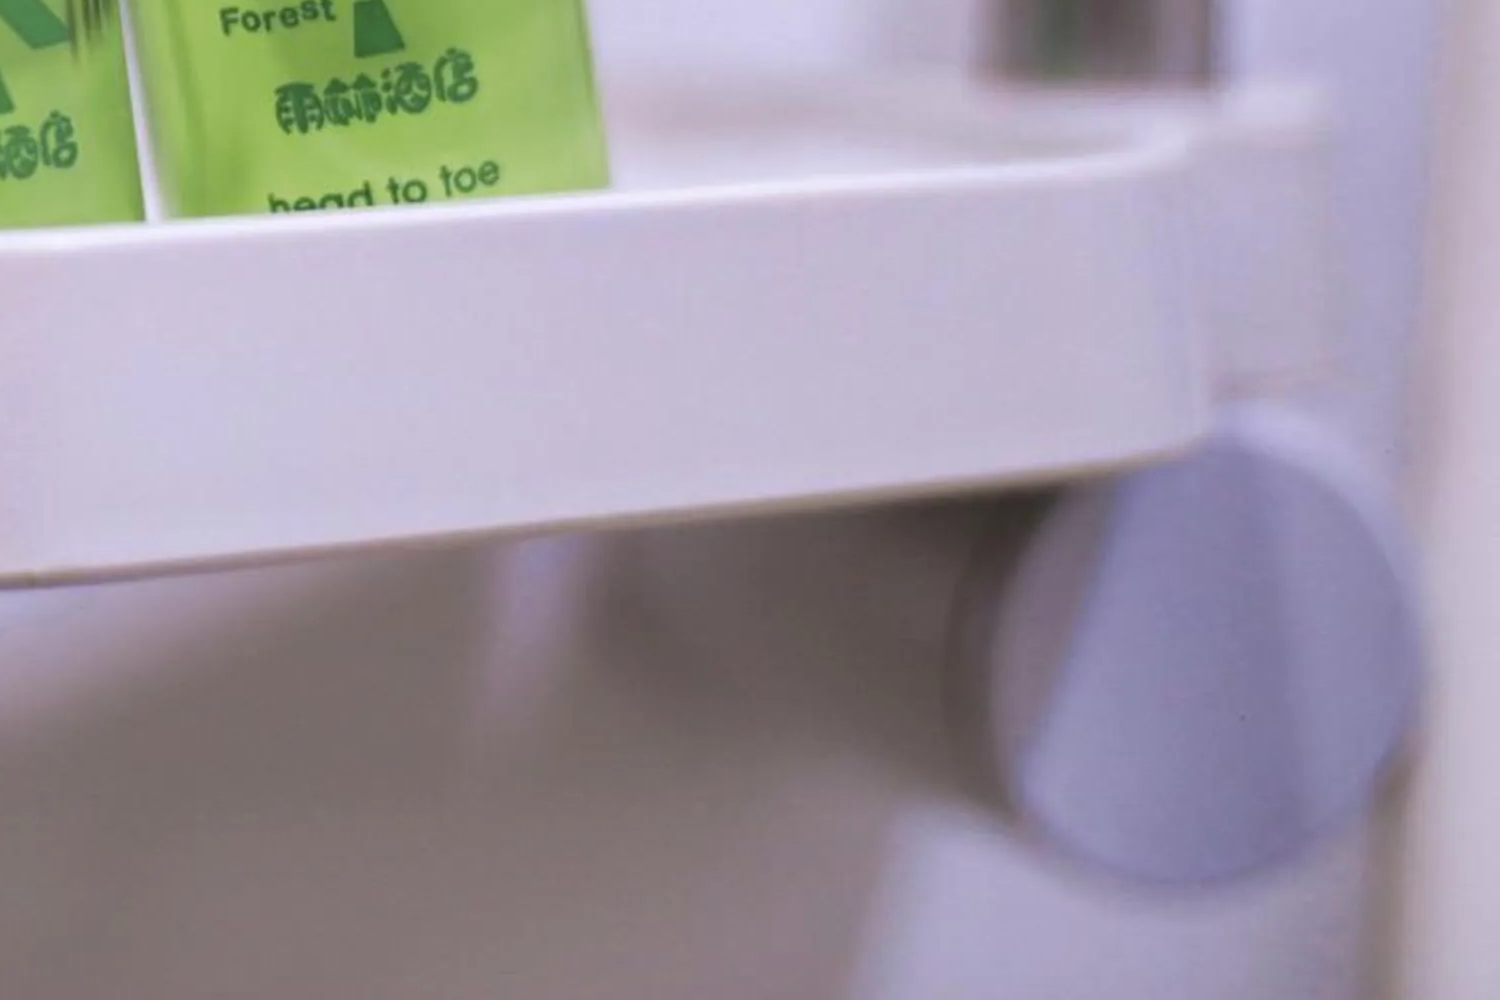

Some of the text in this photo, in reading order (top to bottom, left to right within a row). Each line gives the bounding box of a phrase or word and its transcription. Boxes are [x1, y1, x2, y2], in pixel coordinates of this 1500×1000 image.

[274, 46, 479, 135] 雨林酒店
[387, 177, 428, 206] to
[439, 159, 501, 199] toe
